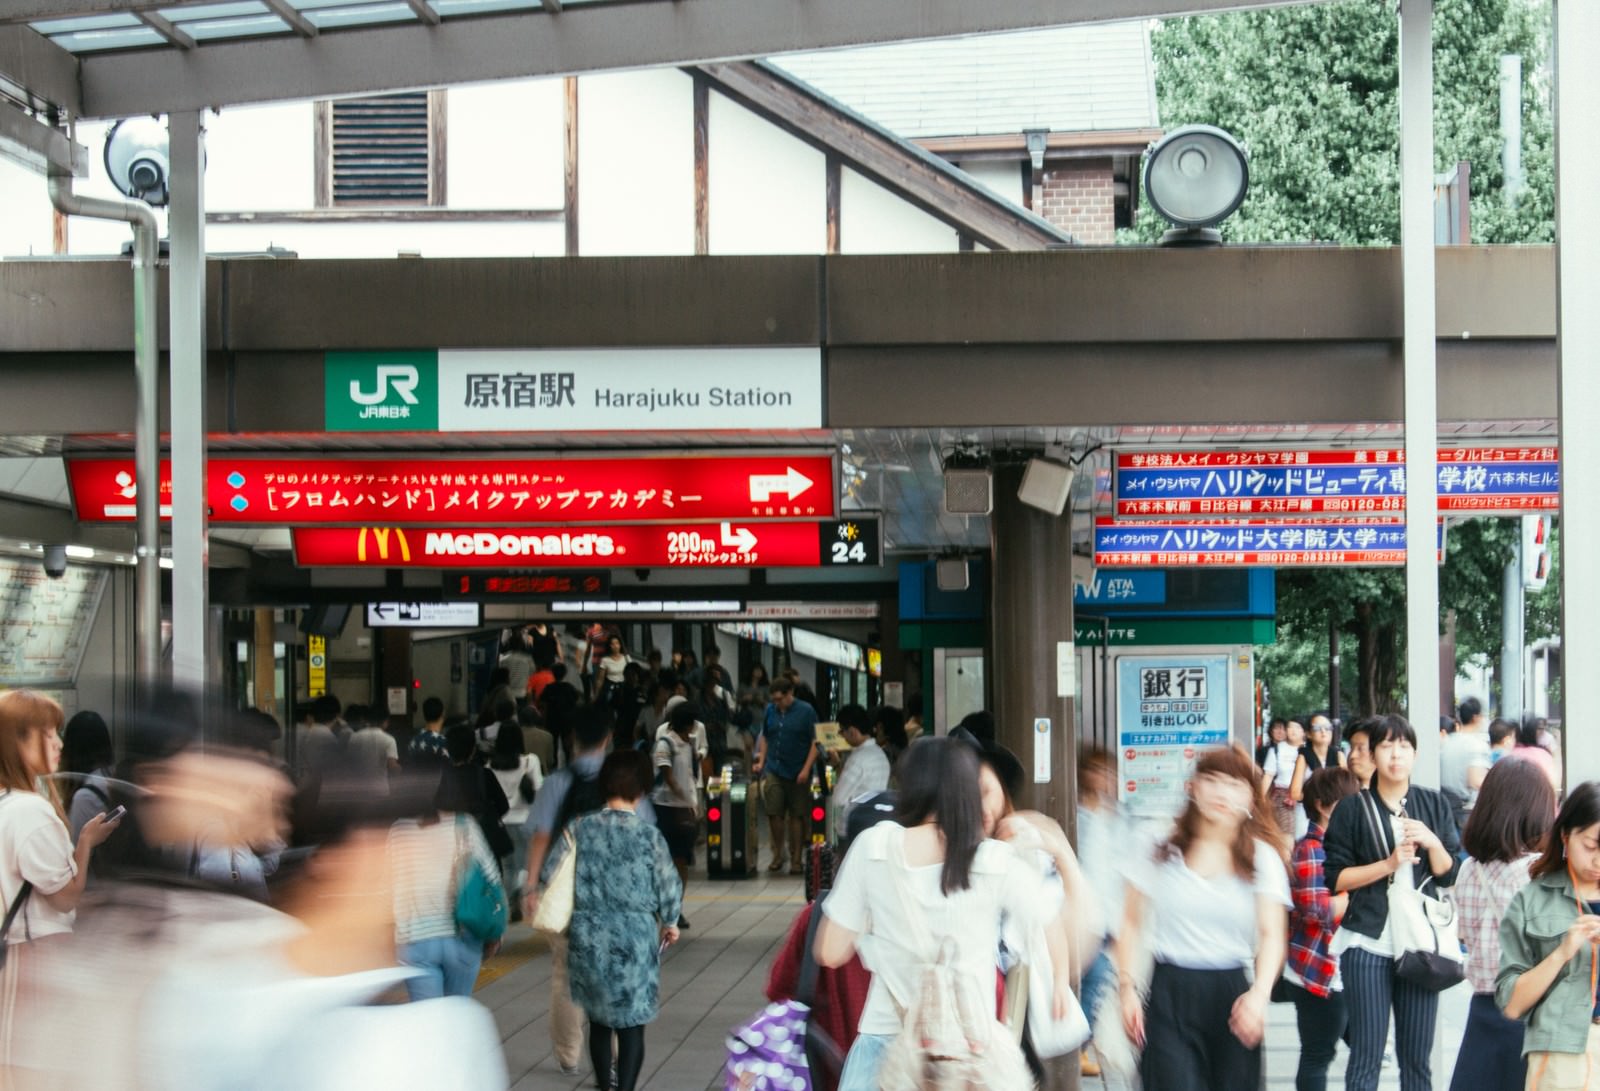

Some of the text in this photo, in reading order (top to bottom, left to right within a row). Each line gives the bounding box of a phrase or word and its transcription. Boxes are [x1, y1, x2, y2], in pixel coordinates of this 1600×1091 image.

[350, 364, 419, 405] JR
[464, 372, 792, 411] 原宿駅 Harajuku Station
[359, 405, 411, 418] JR東日本
[1199, 499, 1253, 512] 日比谷線
[1260, 499, 1313, 512] 大江戸線
[424, 532, 615, 555] McDonald's
[667, 531, 716, 553] 200m
[831, 542, 867, 563] 24
[1107, 578, 1134, 590] ATM
[1142, 668, 1205, 698] 銀行
[1141, 713, 1208, 727] 引き出しOK
